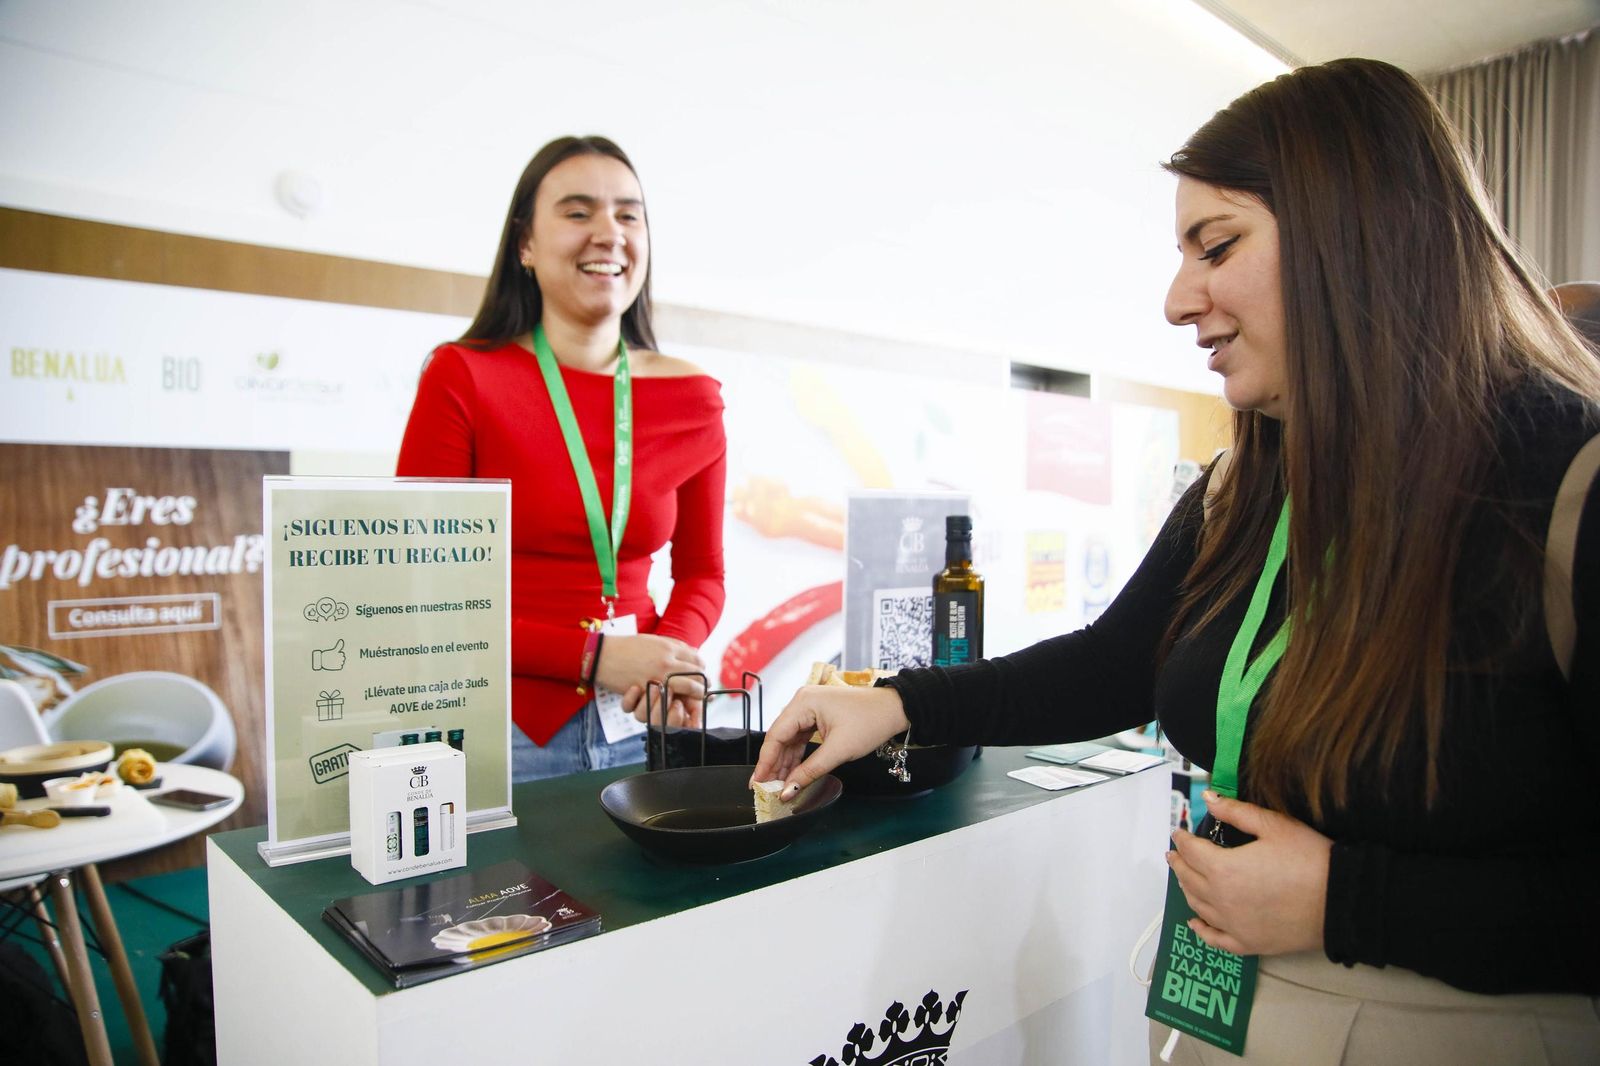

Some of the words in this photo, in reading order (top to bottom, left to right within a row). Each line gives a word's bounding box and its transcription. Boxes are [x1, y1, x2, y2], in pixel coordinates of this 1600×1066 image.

[161, 356, 201, 391] BIO
[72, 488, 197, 534] ¿Eres
[403, 519, 428, 535] EN
[433, 519, 484, 534] RRSS
[487, 518, 499, 534] Y
[0, 534, 263, 590] profesional?
[289, 549, 369, 567] RECIBE
[374, 548, 401, 565] TU
[406, 546, 492, 564] REGALO!
[68, 606, 155, 628] Consulta
[159, 602, 204, 624] aquí
[356, 604, 403, 618] Síguenos
[405, 604, 418, 613] en
[420, 602, 463, 612] nuestras
[465, 599, 492, 610] RRSS
[359, 644, 429, 659] Muéstranoslo
[431, 645, 443, 654] en
[445, 642, 454, 652] el
[456, 641, 489, 652] evento
[364, 685, 406, 700] ¡Llévate
[408, 684, 427, 694] una
[428, 681, 449, 693] caja
[451, 680, 463, 691] de
[465, 677, 489, 689] 3uds
[390, 702, 419, 714] AOVE
[421, 701, 434, 711] de
[314, 750, 353, 776] GRATI
[409, 774, 429, 789] CB
[468, 893, 498, 904] ALMA
[500, 883, 529, 896] AOVE
[1174, 923, 1191, 943] EL
[1172, 939, 1203, 962] NOS
[1205, 953, 1243, 978] SABE
[1169, 954, 1241, 996] TAAAAN
[1161, 970, 1238, 1027] BIEN
